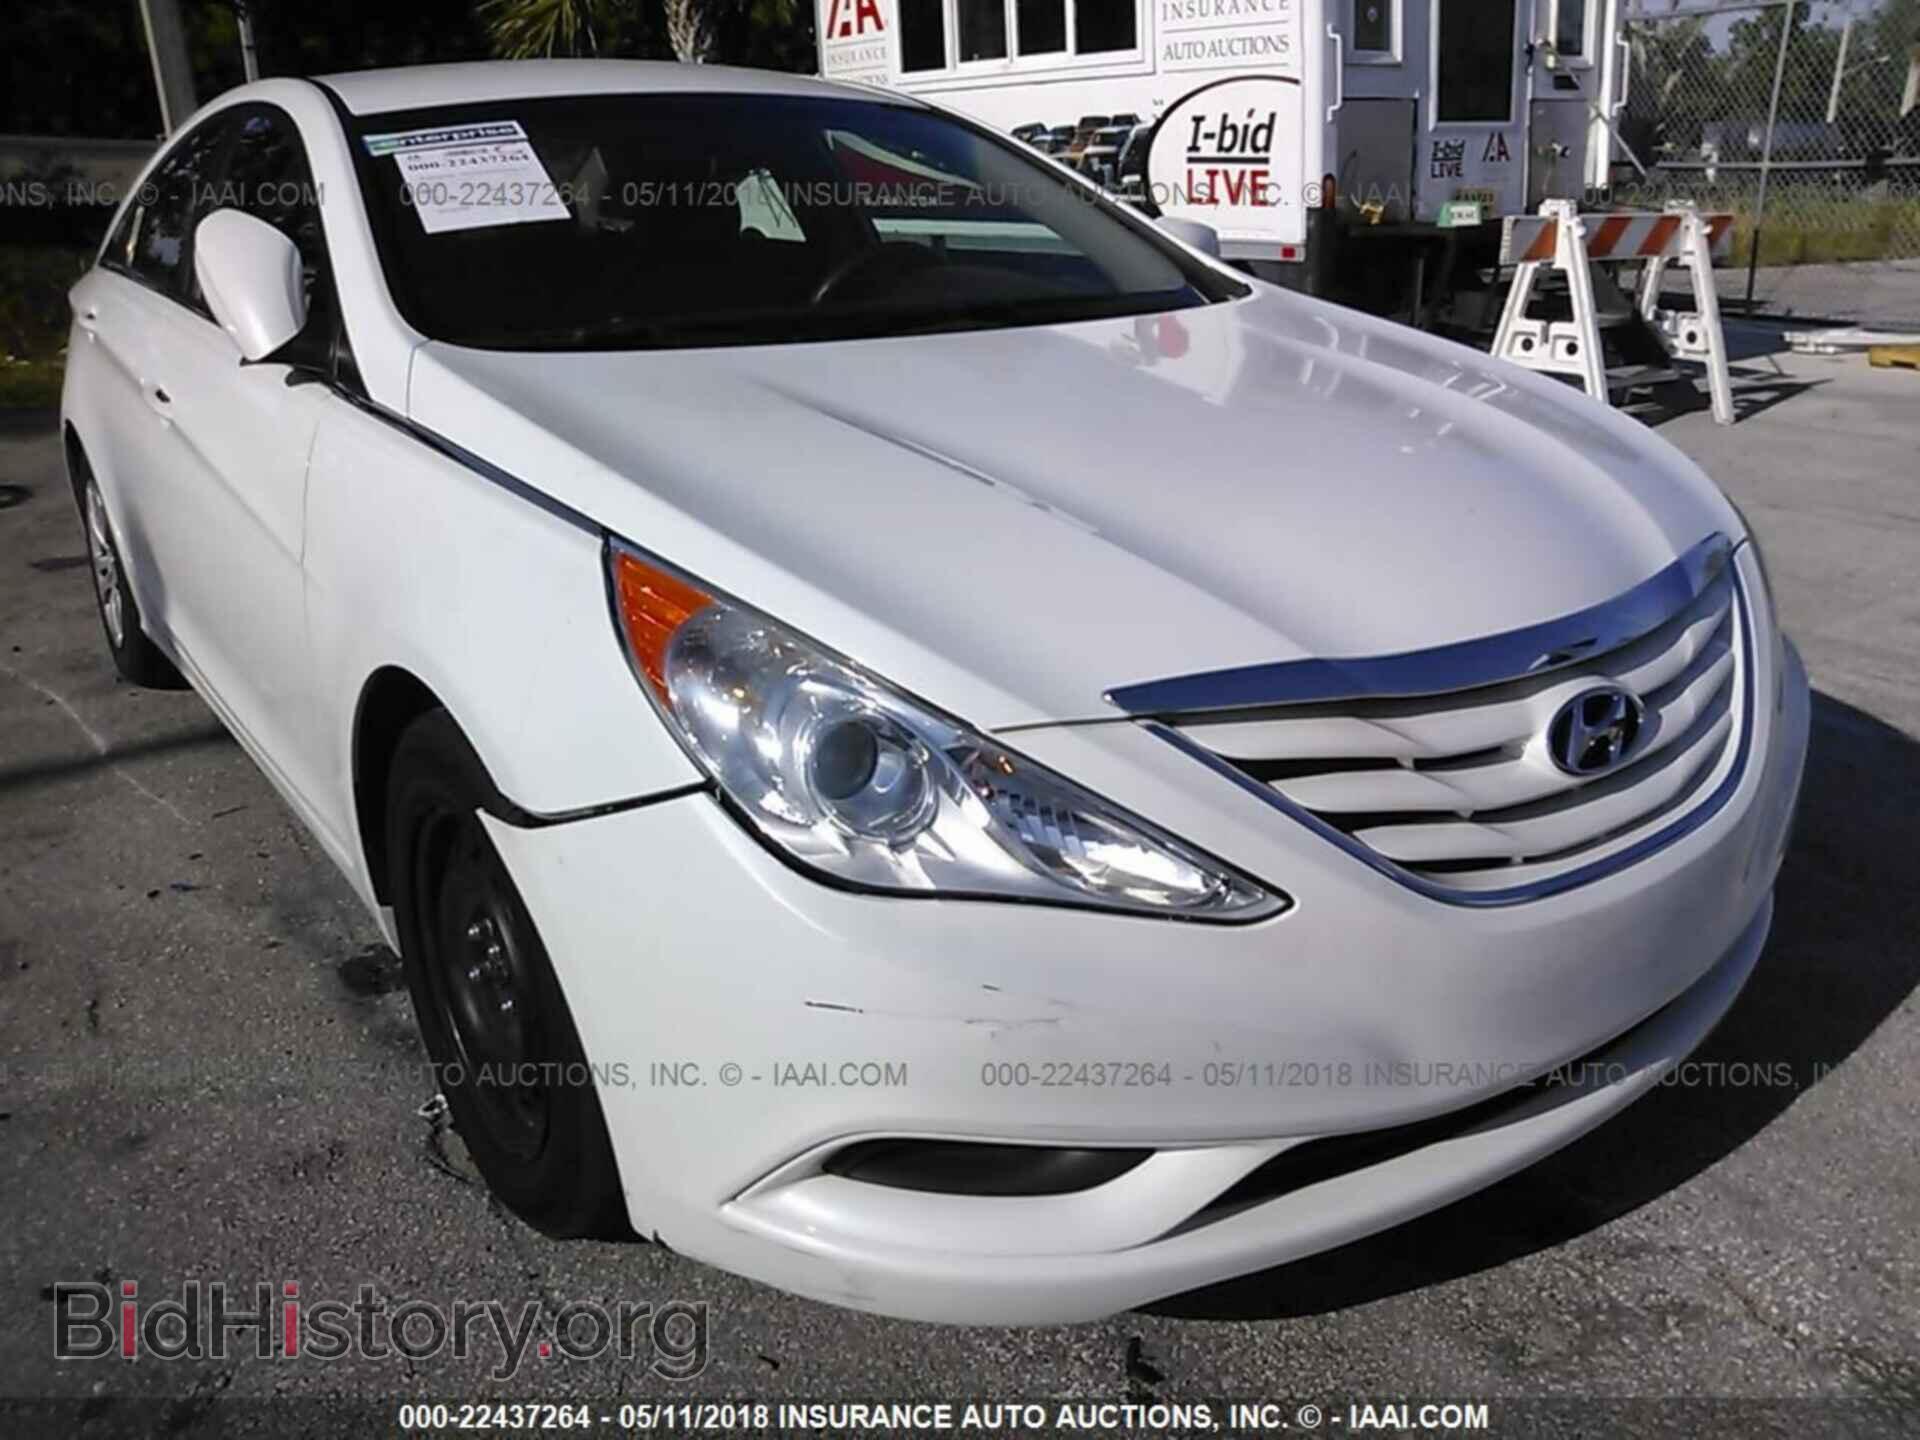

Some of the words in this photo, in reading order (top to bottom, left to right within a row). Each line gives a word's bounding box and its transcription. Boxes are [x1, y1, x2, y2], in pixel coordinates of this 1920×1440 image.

[1162, 0, 1289, 21] INSURANCE
[1163, 41, 1206, 61] AUTO
[1208, 34, 1290, 57] AUCTIONS
[1187, 108, 1277, 153] I-bid
[1431, 161, 1463, 178] LIVE
[1187, 169, 1269, 207] LIVE
